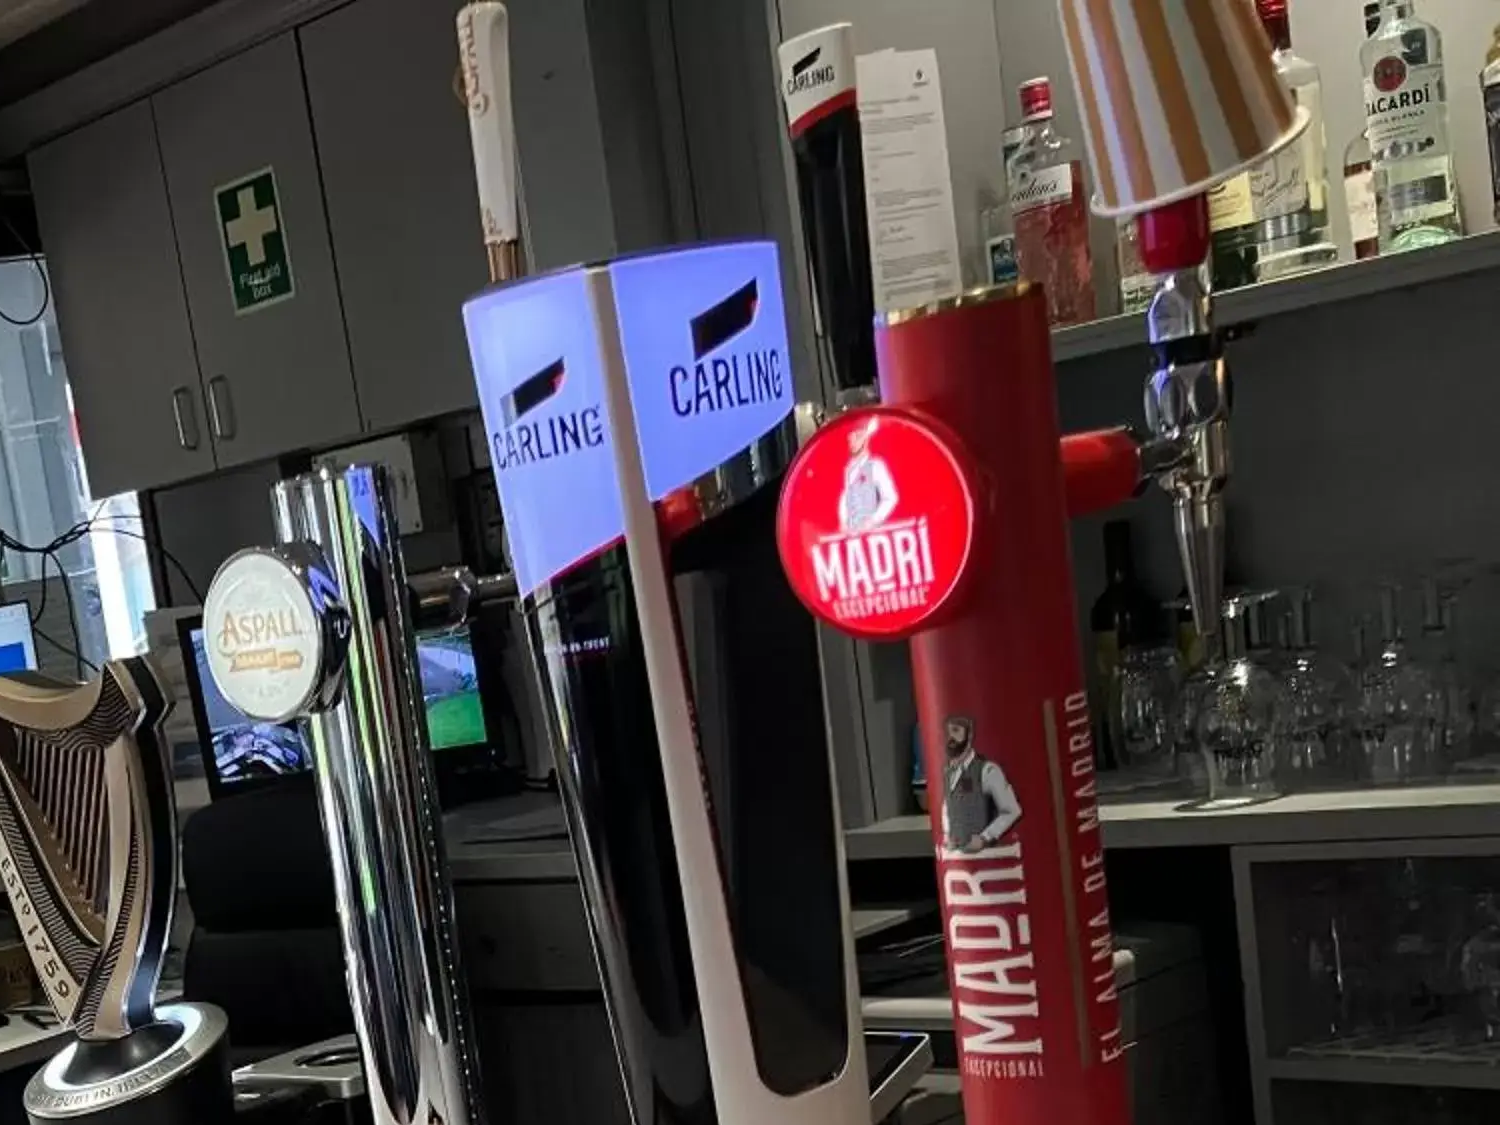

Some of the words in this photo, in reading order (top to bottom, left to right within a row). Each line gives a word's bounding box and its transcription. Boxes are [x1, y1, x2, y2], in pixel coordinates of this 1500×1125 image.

[787, 65, 835, 96] CARLING
[1011, 178, 1058, 202] ordon's
[669, 348, 785, 418] CARLING
[492, 404, 605, 470] CARLING
[811, 514, 936, 604] MADRÍ
[221, 606, 303, 650] ASPALL
[1063, 688, 1101, 835] MADRID
[1079, 850, 1108, 896] DE
[26, 924, 71, 999] 1759
[1089, 904, 1118, 1004] ALMA
